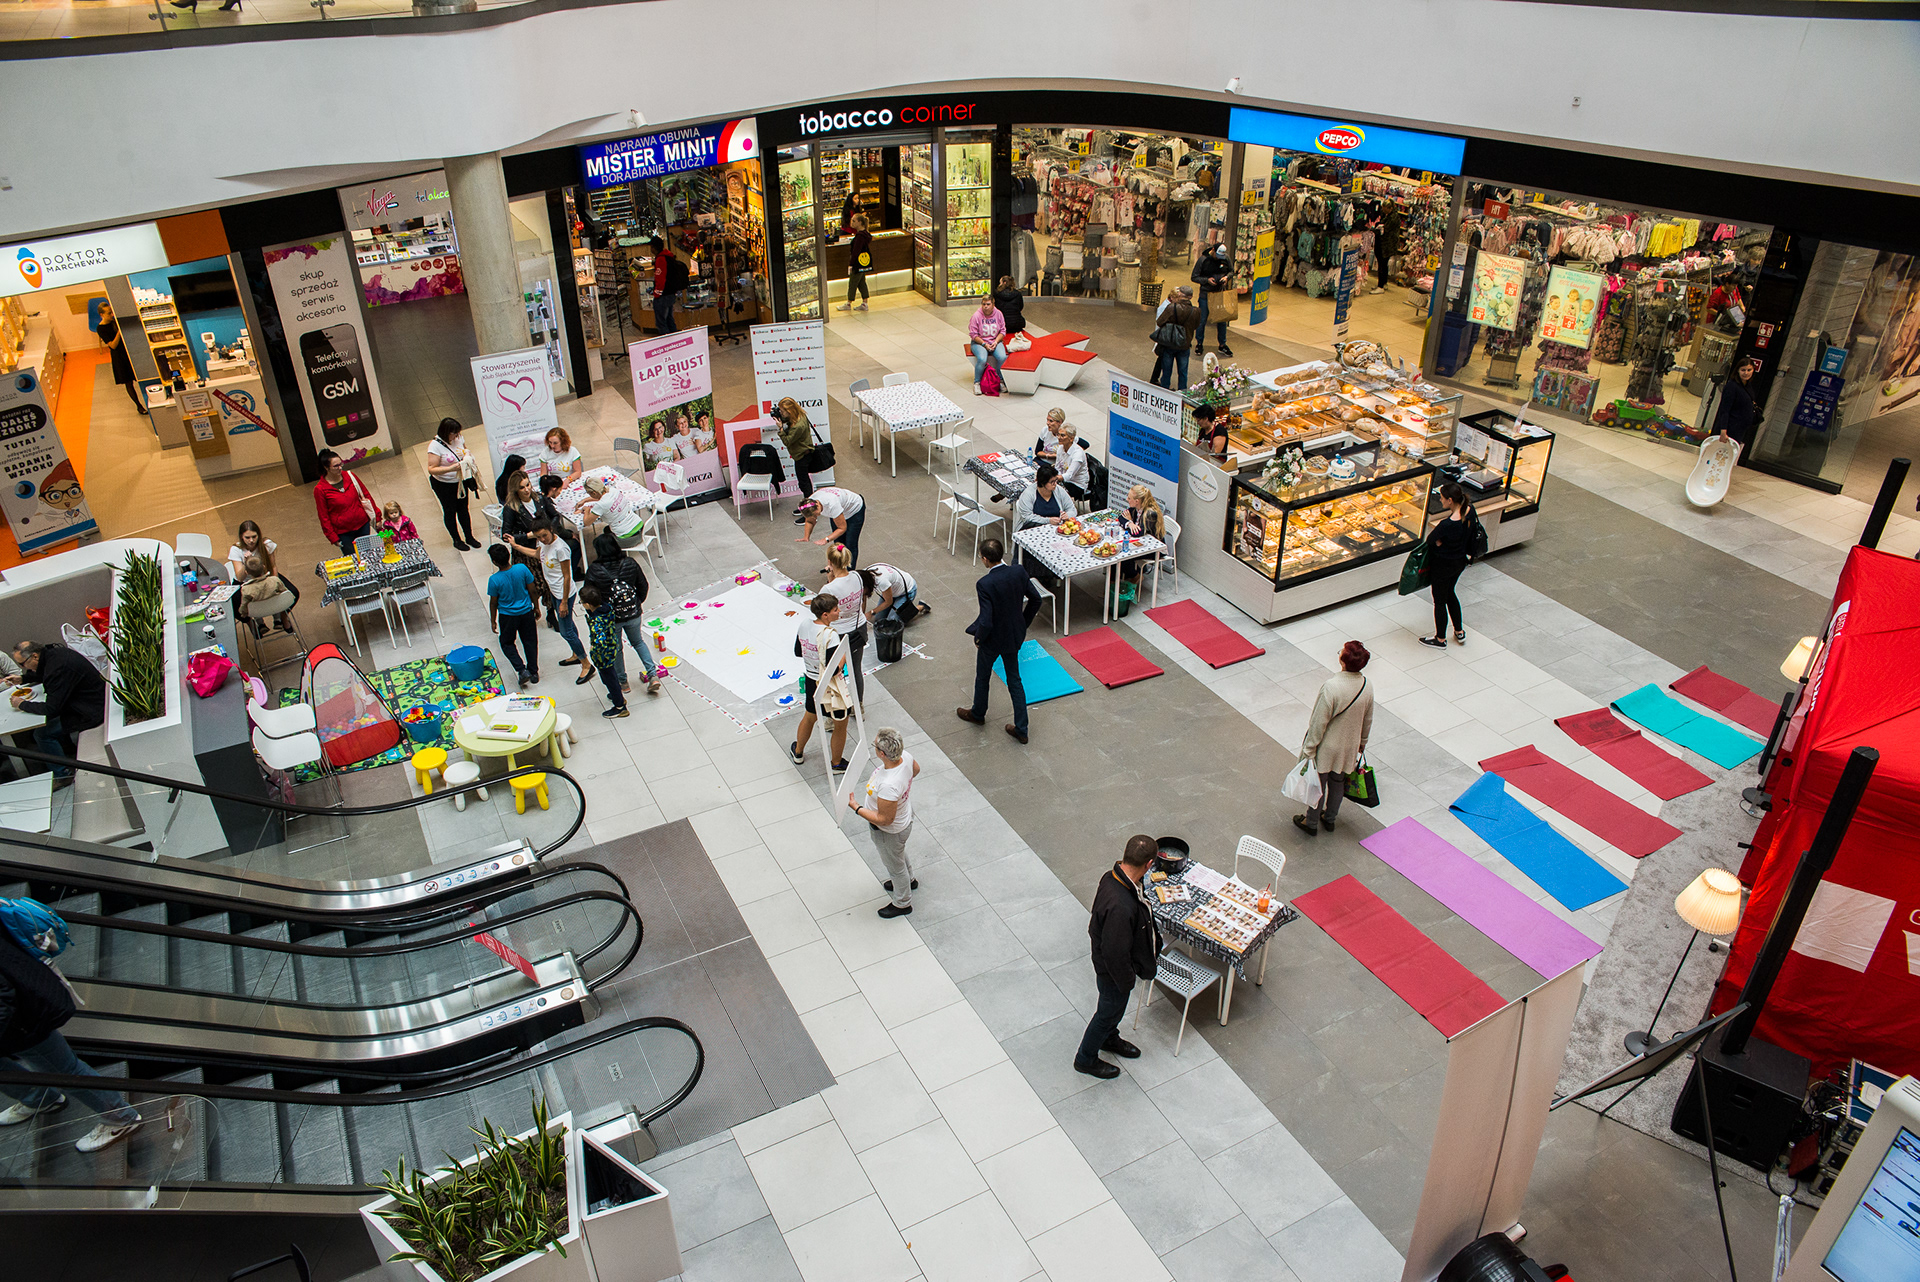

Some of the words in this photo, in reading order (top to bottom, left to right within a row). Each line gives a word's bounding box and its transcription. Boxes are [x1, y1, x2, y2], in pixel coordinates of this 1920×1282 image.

[799, 108, 893, 135] tobacco
[900, 103, 976, 123] corner
[605, 138, 657, 155] NAPRAWA
[659, 127, 700, 144] OBUWIA
[1322, 133, 1357, 147] PEPCO
[586, 147, 656, 178] MISTER
[663, 136, 716, 163] MINIT
[601, 164, 665, 185] DORABIANIE
[667, 156, 706, 173] KLUCZY
[366, 188, 396, 217] Virgin
[1491, 204, 1501, 215] HIT
[42, 247, 106, 266] DOKTOR
[46, 257, 109, 273] MARCHEWKA
[300, 269, 324, 282] skup
[291, 279, 339, 297] sprzedaż
[301, 294, 335, 308] serwis
[296, 304, 346, 322] akcesoria
[982, 323, 998, 337] 96
[315, 350, 350, 364] Telefony
[651, 347, 664, 356] akcja
[665, 340, 687, 352] społeczna
[311, 356, 358, 375] komórkowe
[481, 356, 541, 374] Stowarzyszenie
[495, 370, 515, 379] Śląskich
[516, 366, 542, 375] Amazonek
[639, 364, 663, 382] ŁAP
[667, 354, 704, 375] BIUST
[323, 378, 360, 400] GSM
[1132, 388, 1149, 403] DIET
[1150, 395, 1179, 415] EXPERT
[0, 412, 37, 430] DAŁEŚ
[1132, 402, 1162, 420] KATARZYNA
[1162, 412, 1178, 426] TUREK
[0, 421, 37, 437] ZROK?
[4, 436, 37, 451] TUTAJ
[1145, 440, 1172, 456] INTERNETOWA
[4, 453, 53, 473] BADANIA
[1122, 449, 1164, 470] WWW.DIET-EXPERT.PL
[8, 461, 54, 480] WZROKU
[687, 471, 713, 484] orcza
